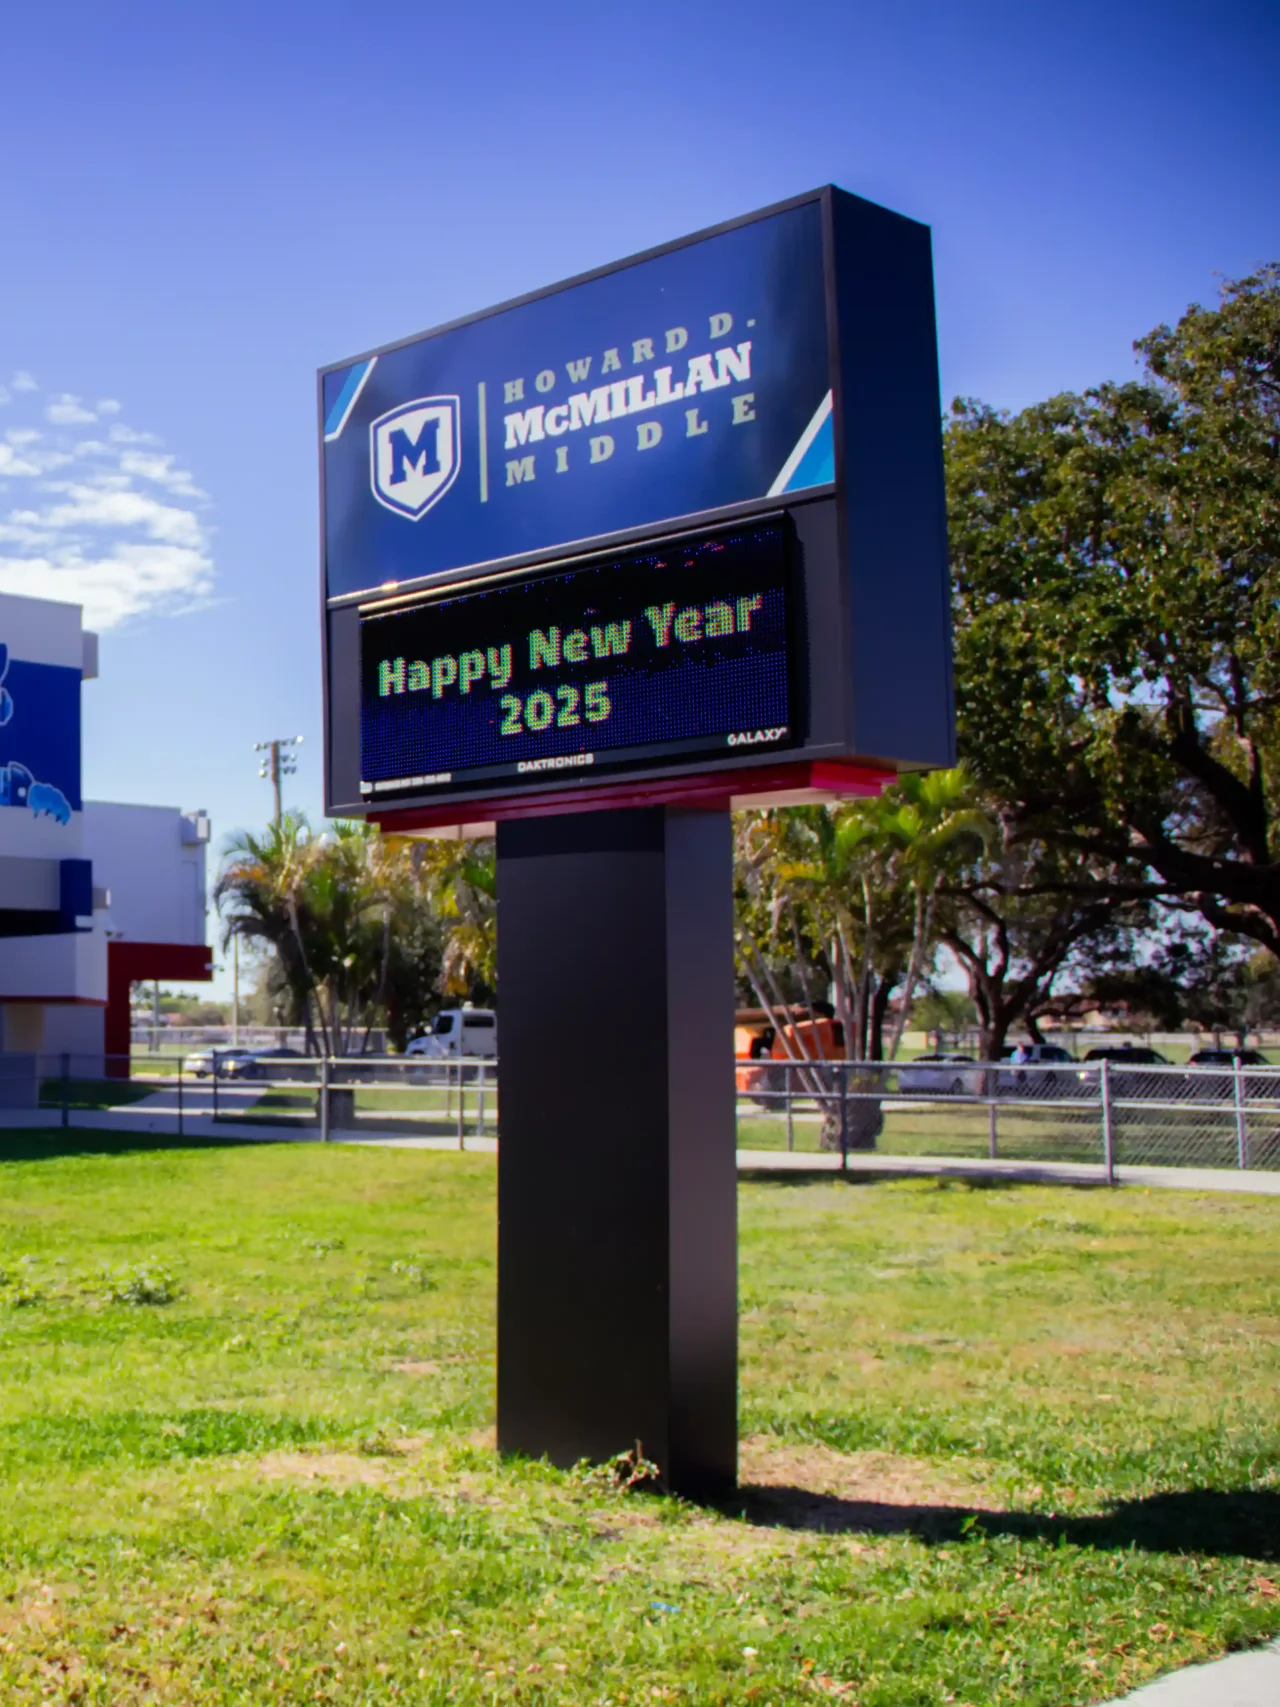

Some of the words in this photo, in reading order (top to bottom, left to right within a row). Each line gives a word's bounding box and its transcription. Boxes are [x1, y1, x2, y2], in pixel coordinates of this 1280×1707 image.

[504, 327, 688, 403] HOWARD
[709, 312, 755, 339] D.
[504, 341, 752, 449] McMILLAN
[388, 414, 442, 487] M
[505, 393, 755, 487] MIDDLE
[378, 644, 512, 699] Happy
[529, 619, 632, 670] New
[644, 592, 763, 648] Year
[500, 681, 613, 736] 2025
[727, 727, 788, 746] GALAXY
[517, 753, 595, 773] DAKTRONICS
